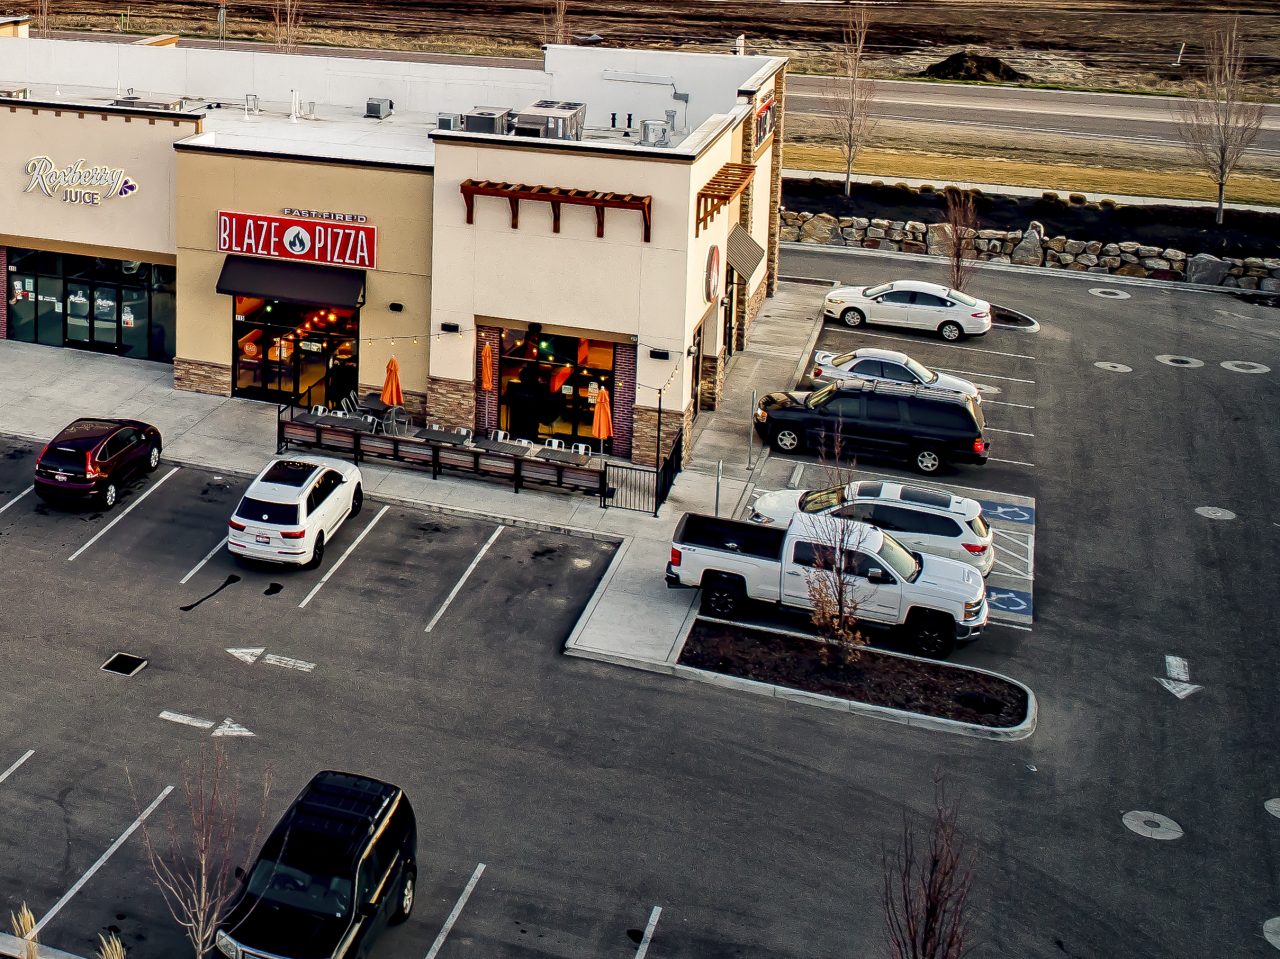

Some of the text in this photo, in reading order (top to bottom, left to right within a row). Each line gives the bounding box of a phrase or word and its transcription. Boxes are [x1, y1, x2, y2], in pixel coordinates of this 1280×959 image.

[22, 156, 124, 200] Roxberry
[63, 189, 100, 205] JUICE
[220, 216, 370, 266] BLAZE PIZZA
